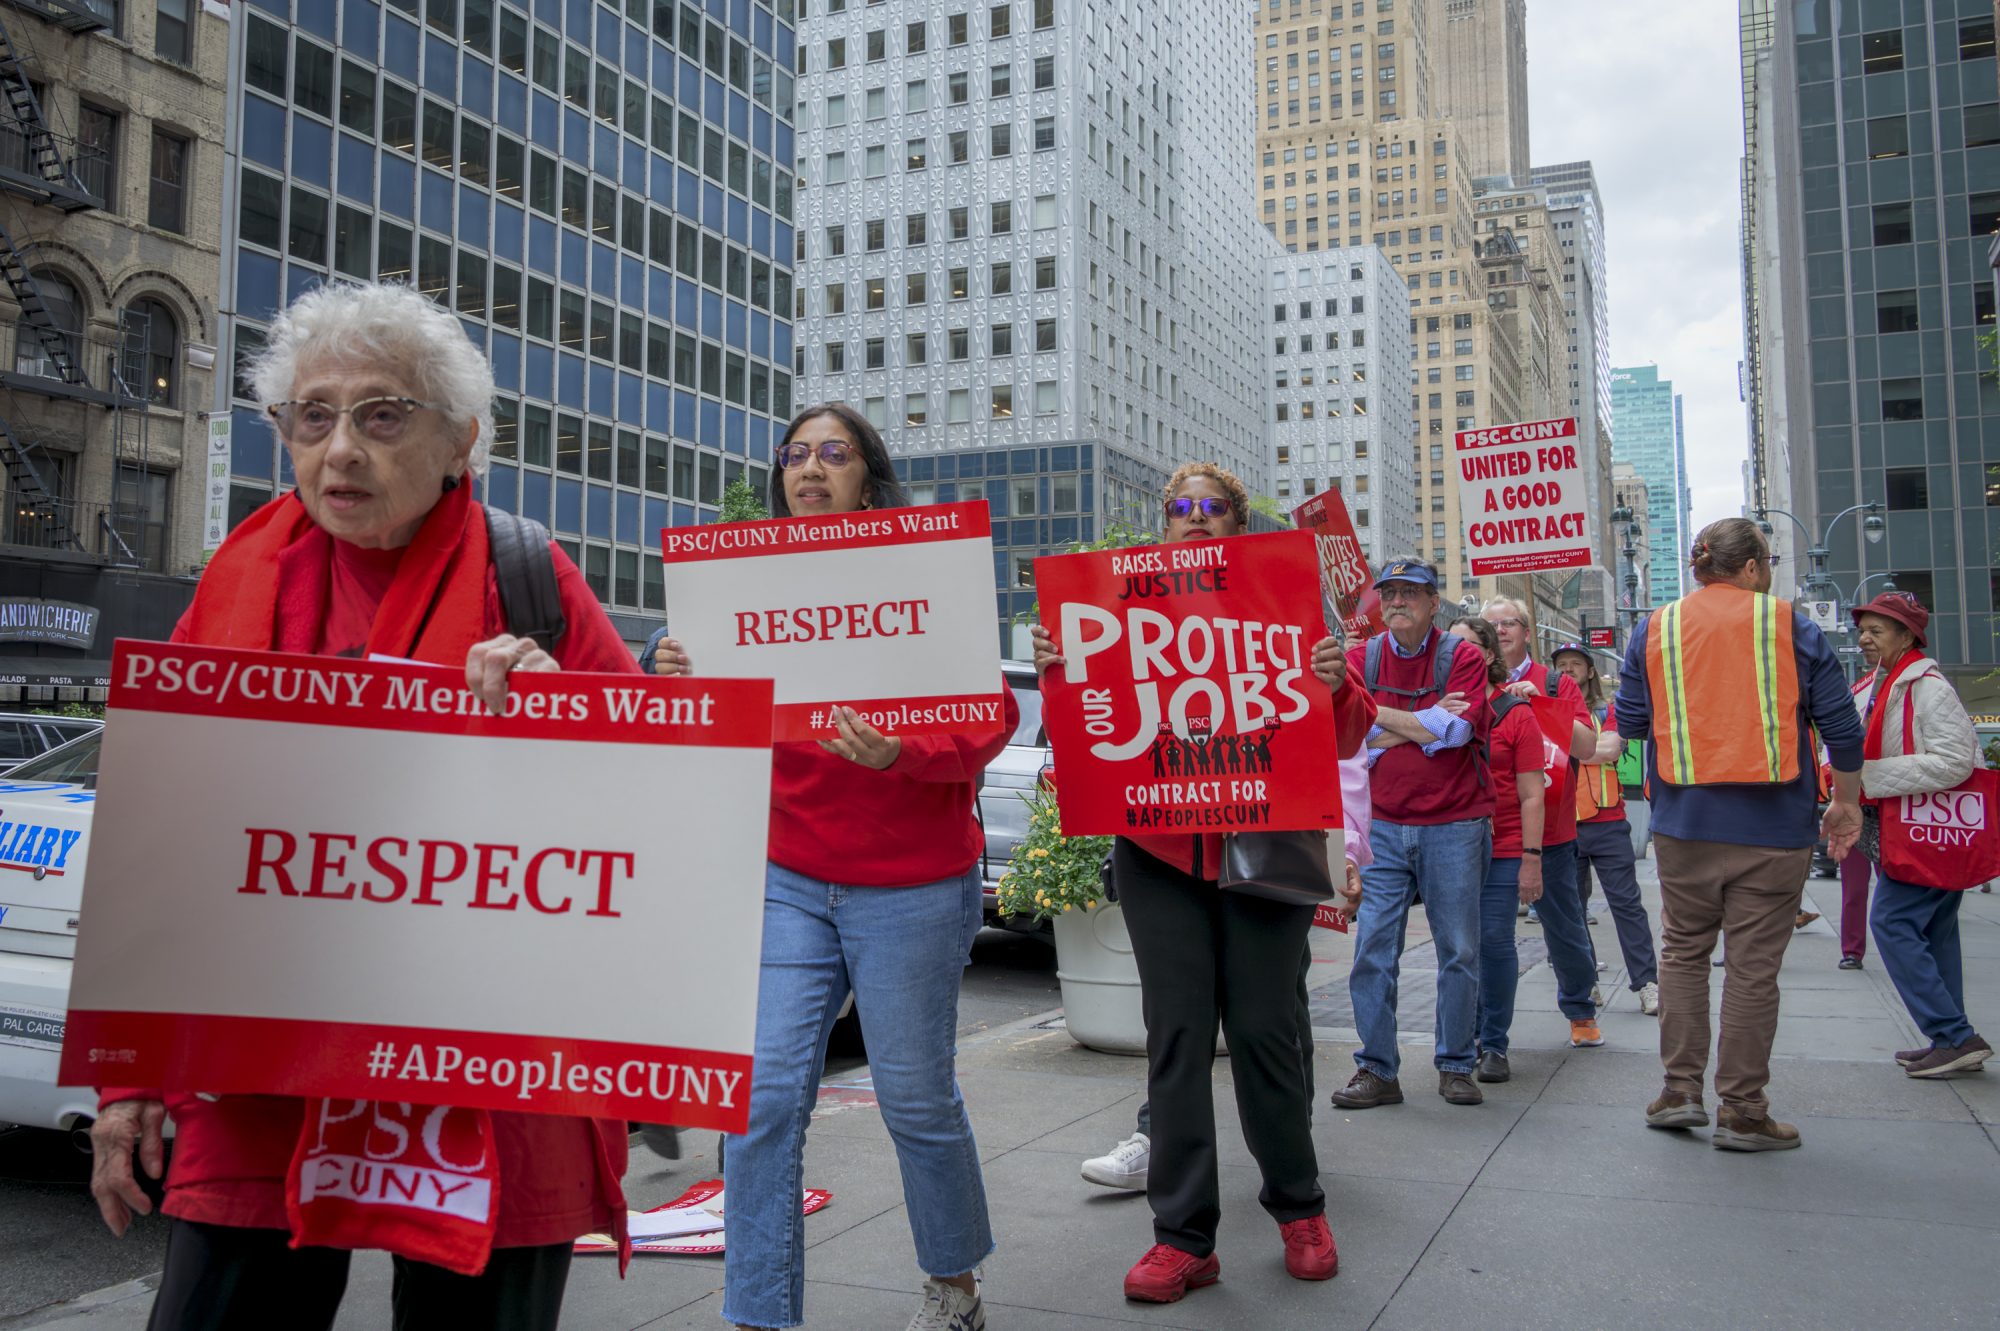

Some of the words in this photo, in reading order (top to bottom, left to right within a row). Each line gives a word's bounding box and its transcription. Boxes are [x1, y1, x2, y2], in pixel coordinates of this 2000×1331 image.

[212, 420, 229, 436] FOOD
[1464, 421, 1566, 448] PSC-CUNY
[212, 463, 226, 478] FOR
[1461, 451, 1532, 482] UNITED
[1537, 445, 1578, 472] FOR
[210, 505, 222, 520] ALL
[1484, 488, 1499, 513] A
[1502, 481, 1562, 511] GOOD
[667, 527, 781, 554] PSC/CUNY
[787, 517, 893, 544] Members
[898, 511, 959, 534] Want
[1469, 512, 1585, 547] CONTRACT
[1112, 551, 1168, 576] RAISES,
[1172, 545, 1228, 570] EQUITY,
[1118, 567, 1228, 600] JUSTICE
[0, 604, 93, 635] ANDWICHERIE
[46, 631, 67, 639] YORK
[735, 599, 930, 646] RESPECT
[1060, 602, 1303, 684] PROTECT
[49, 676, 73, 685] PASTA
[122, 653, 374, 708] PSC/CUNY
[602, 687, 715, 727] Want
[1081, 688, 1115, 735] OUR
[1090, 668, 1310, 761] JOBS
[1188, 717, 1210, 729] PSC
[1265, 717, 1279, 725] PSC
[1125, 781, 1221, 805] CONTRACT
[1231, 780, 1267, 801] FOR
[1903, 791, 1982, 827] PSC
[1909, 826, 1976, 846] CUNY
[237, 828, 635, 918] RESPECT
[3, 1017, 24, 1031] PAL
[27, 1021, 66, 1038] CARES
[367, 1041, 744, 1108] #APeoplesCUNY
[308, 1097, 486, 1174] PSC
[315, 1158, 473, 1207] CUNY
